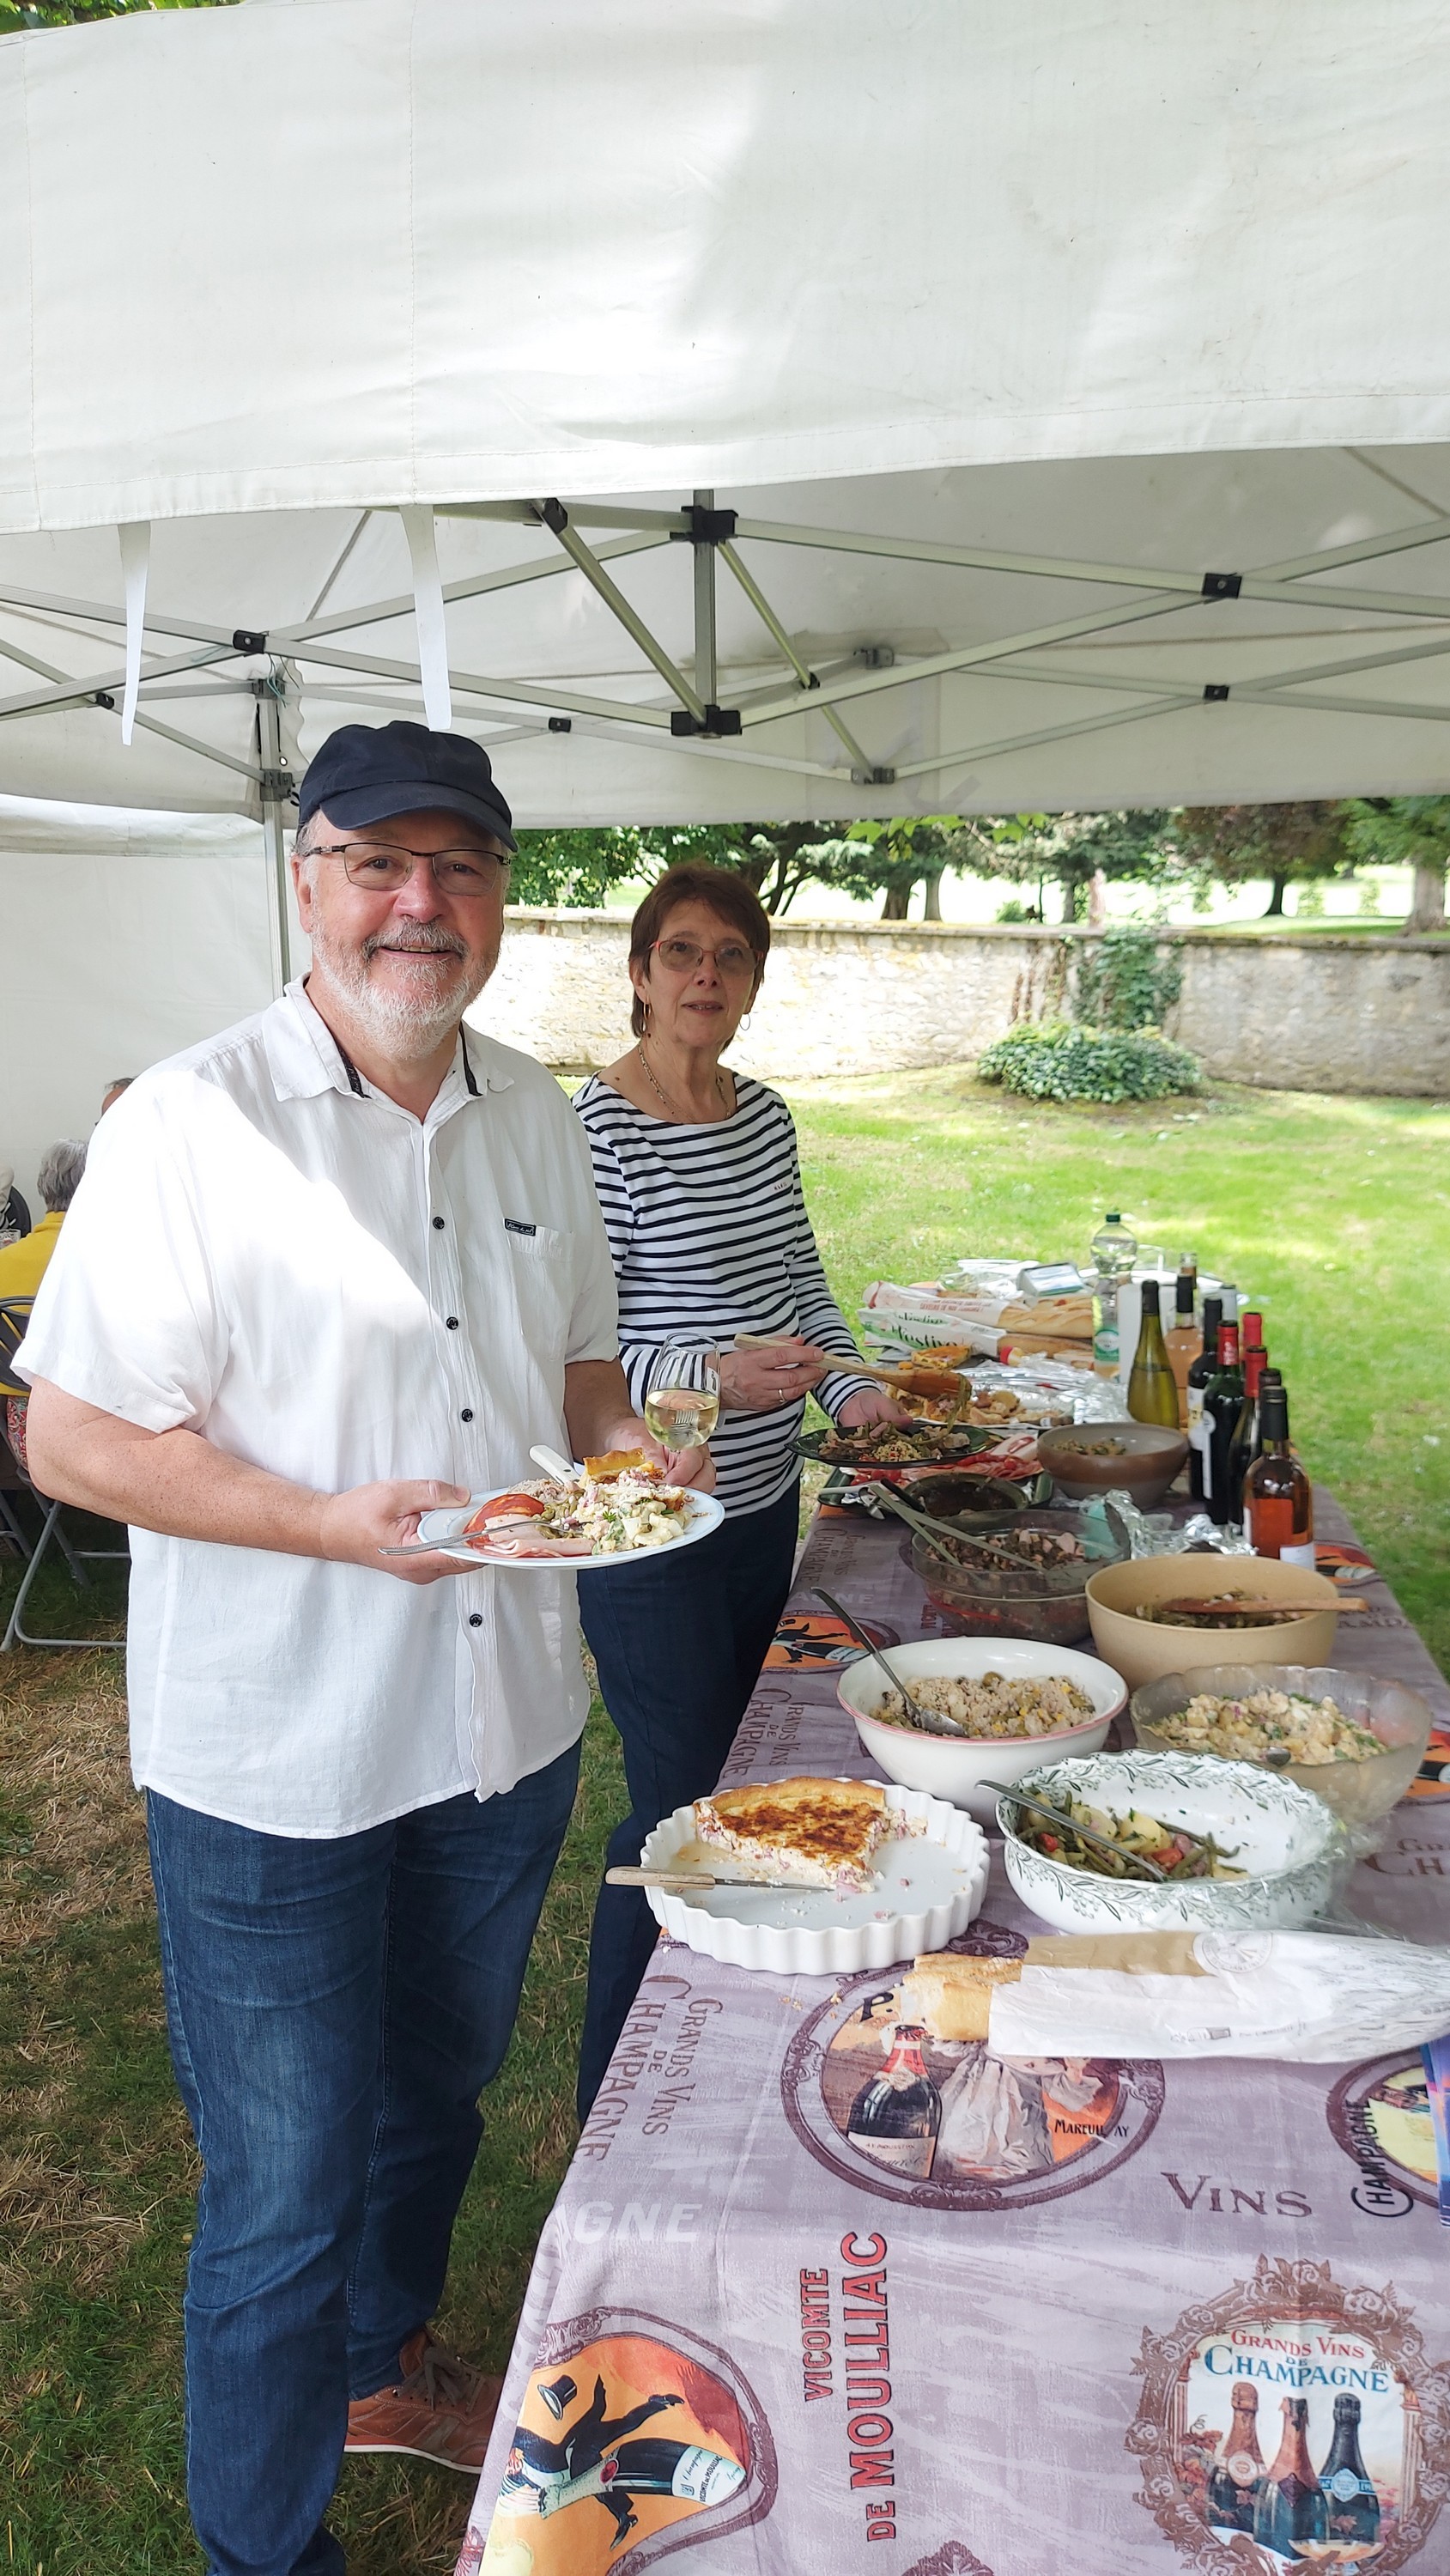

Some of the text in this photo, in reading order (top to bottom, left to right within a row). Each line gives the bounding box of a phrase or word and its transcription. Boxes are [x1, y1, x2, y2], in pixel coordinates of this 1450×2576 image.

[799, 1528, 848, 1582] CHAMPAGNE
[723, 1688, 792, 1778] CHAMPAGNE
[767, 1724, 780, 1738] DE
[573, 1975, 693, 2162] CHAMPAGNE
[641, 1998, 725, 2136] GRANDS VINS
[647, 2050, 668, 2073] DE
[1345, 2099, 1414, 2218] CHAMPAGNE
[1161, 2172, 1313, 2219] VINS
[799, 2268, 834, 2402] VICOMTE
[1230, 2329, 1365, 2359] GRANDS VINS
[1285, 2356, 1308, 2366] DE
[840, 2231, 897, 2543] DE MOULLIAC
[1204, 2344, 1390, 2393] CHAMPAGNE
